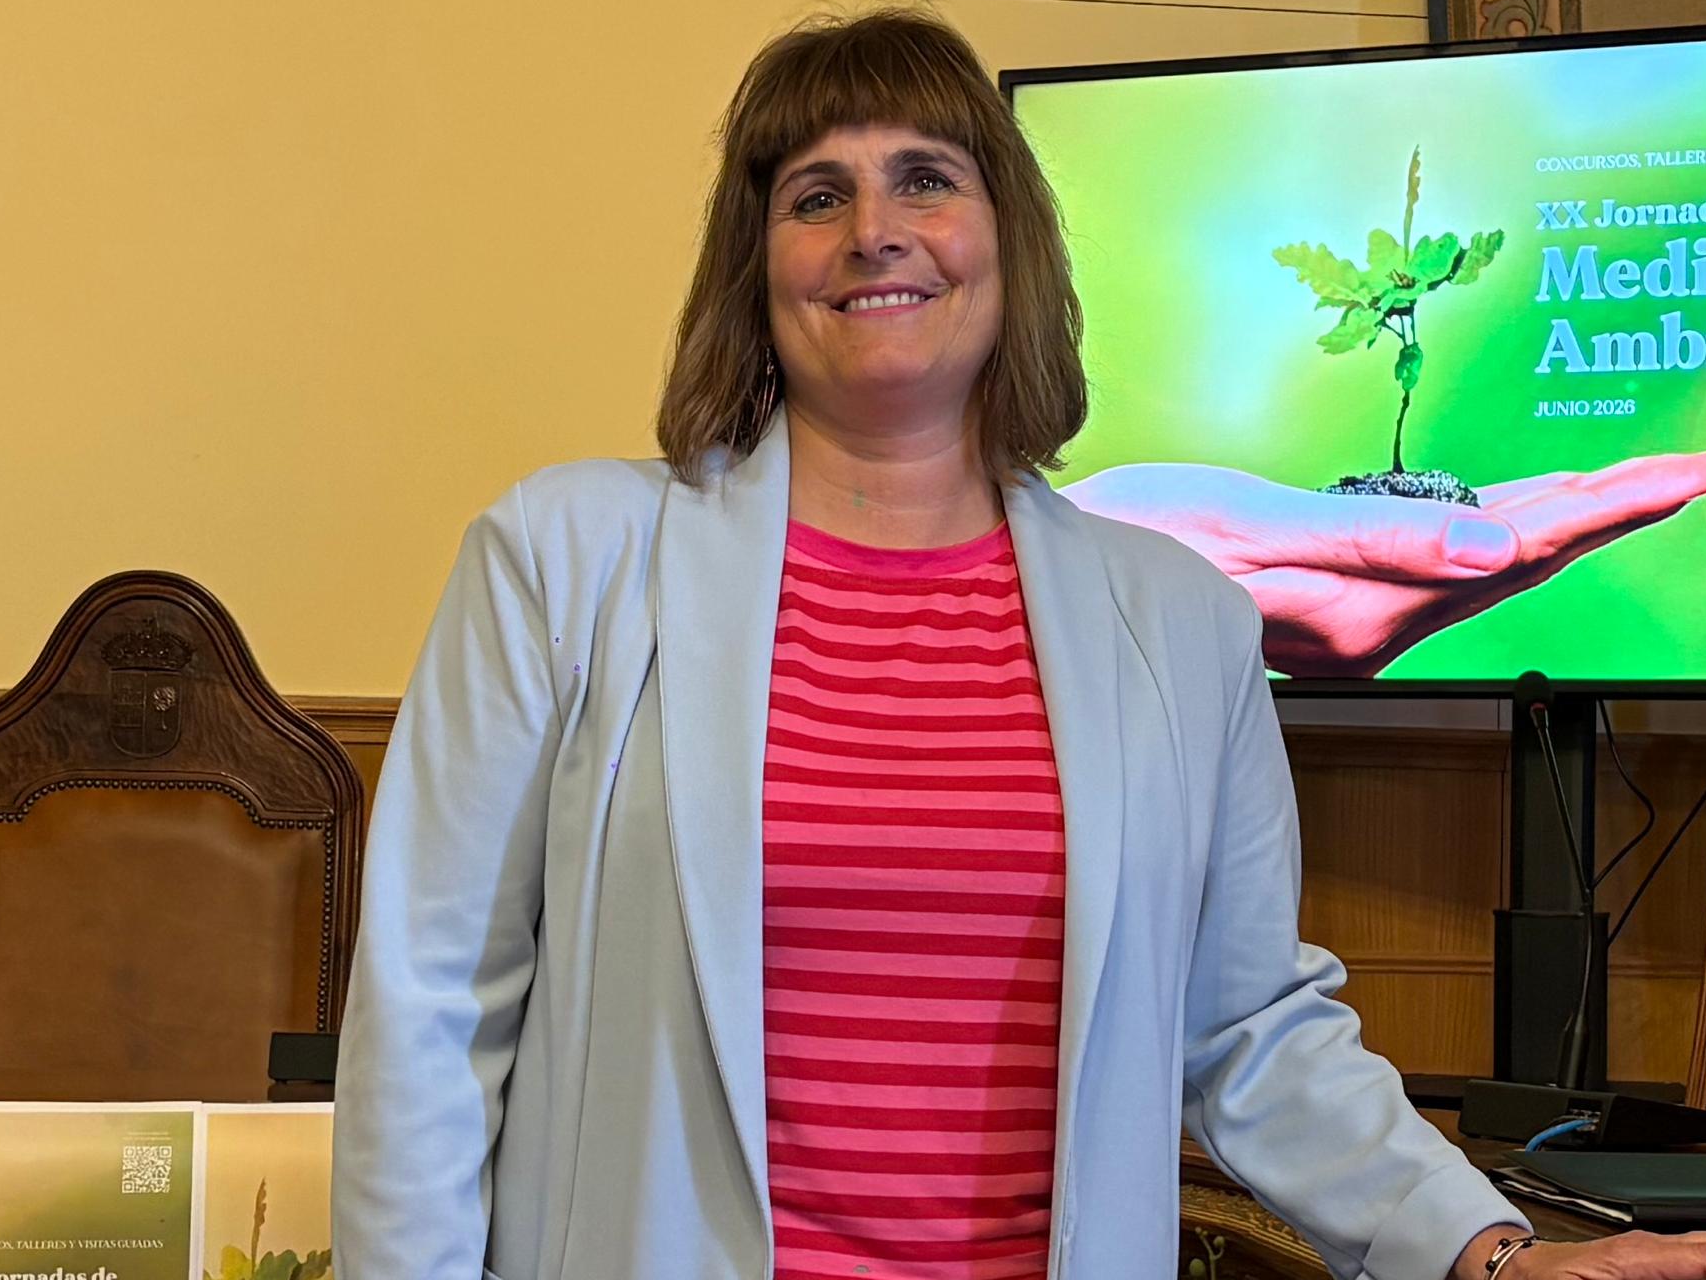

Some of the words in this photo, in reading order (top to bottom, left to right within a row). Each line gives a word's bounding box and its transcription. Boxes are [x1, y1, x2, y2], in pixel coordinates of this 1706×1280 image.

[1535, 152, 1642, 172] CONCURSOS,
[1535, 199, 1590, 231] XX
[1534, 400, 1591, 417] JUNIO
[1593, 398, 1636, 416] 2026
[16, 1239, 67, 1250] TALLERES
[68, 1239, 75, 1249] Y
[78, 1239, 116, 1250] VISITAS
[117, 1238, 164, 1249] GUIADAS
